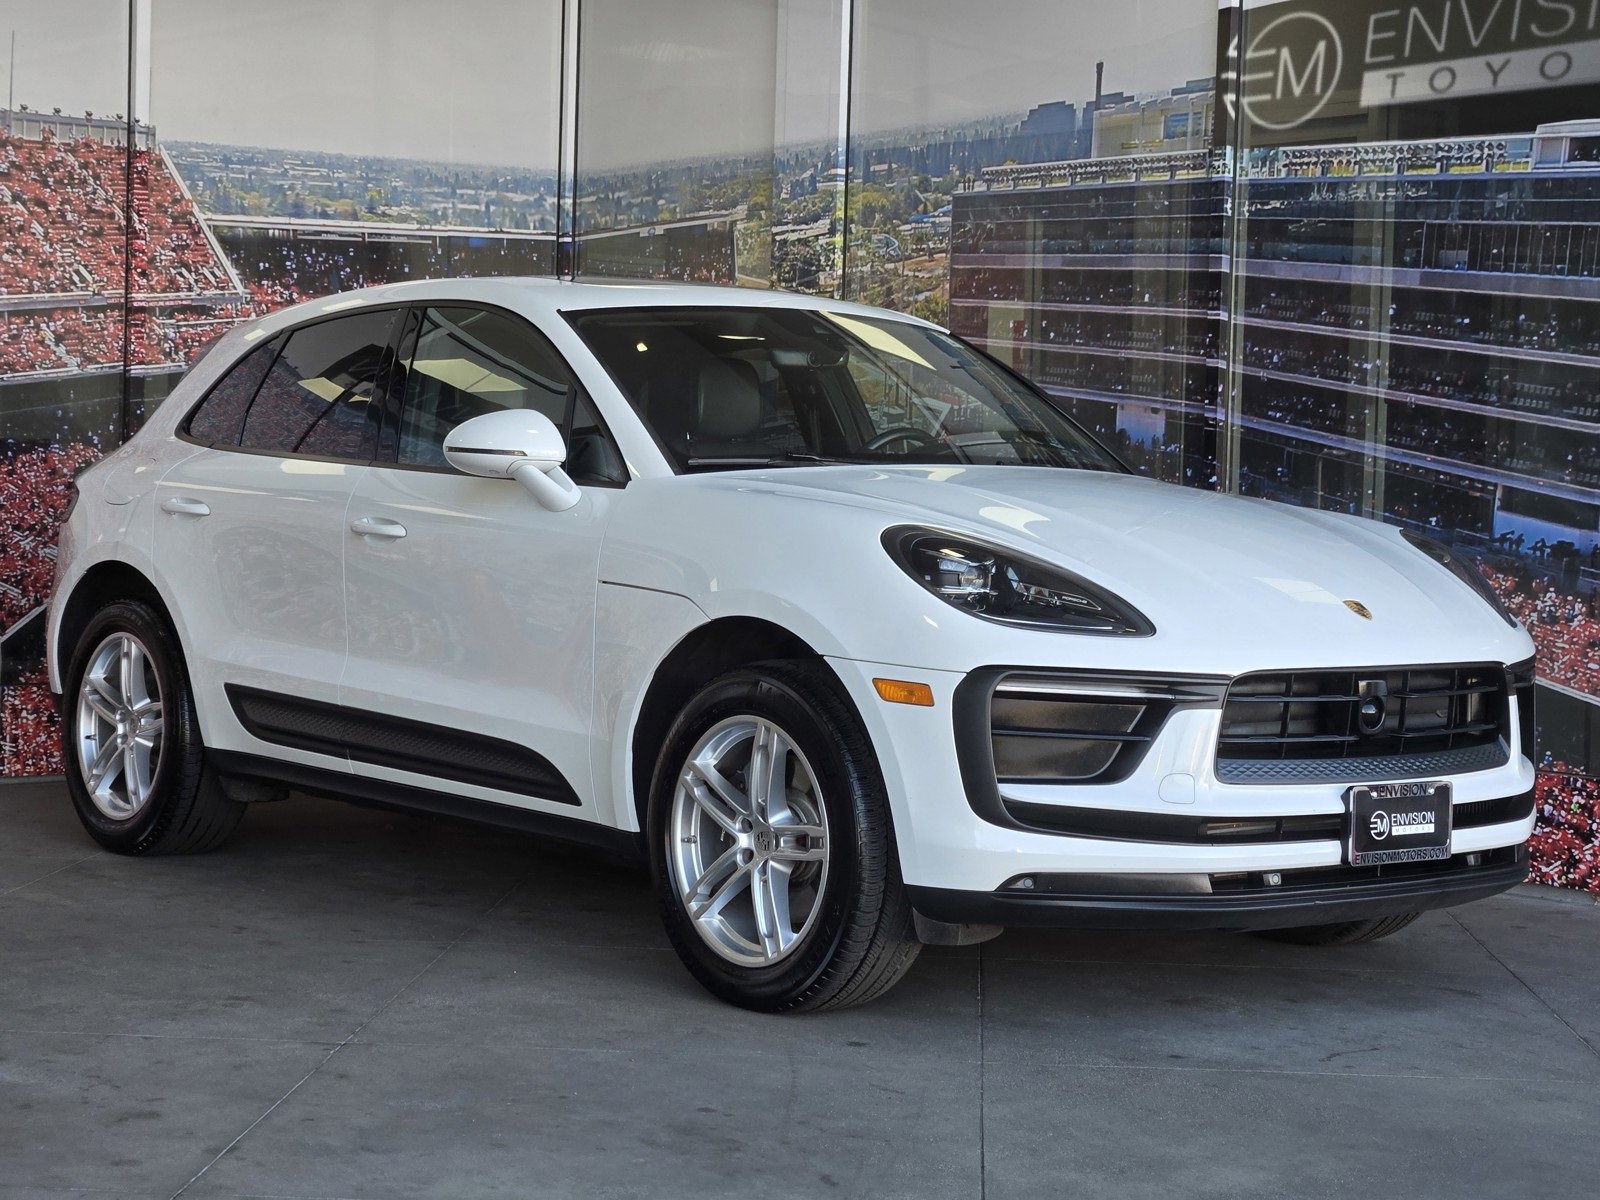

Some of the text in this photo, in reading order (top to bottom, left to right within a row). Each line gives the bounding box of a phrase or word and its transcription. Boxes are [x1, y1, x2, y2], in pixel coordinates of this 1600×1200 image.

[1385, 51, 1574, 99] TOYO
[1379, 784, 1427, 797] ENVISION
[1391, 811, 1435, 826] ENVISION
[1355, 848, 1448, 865] ENVISIONMOTORS.COM
